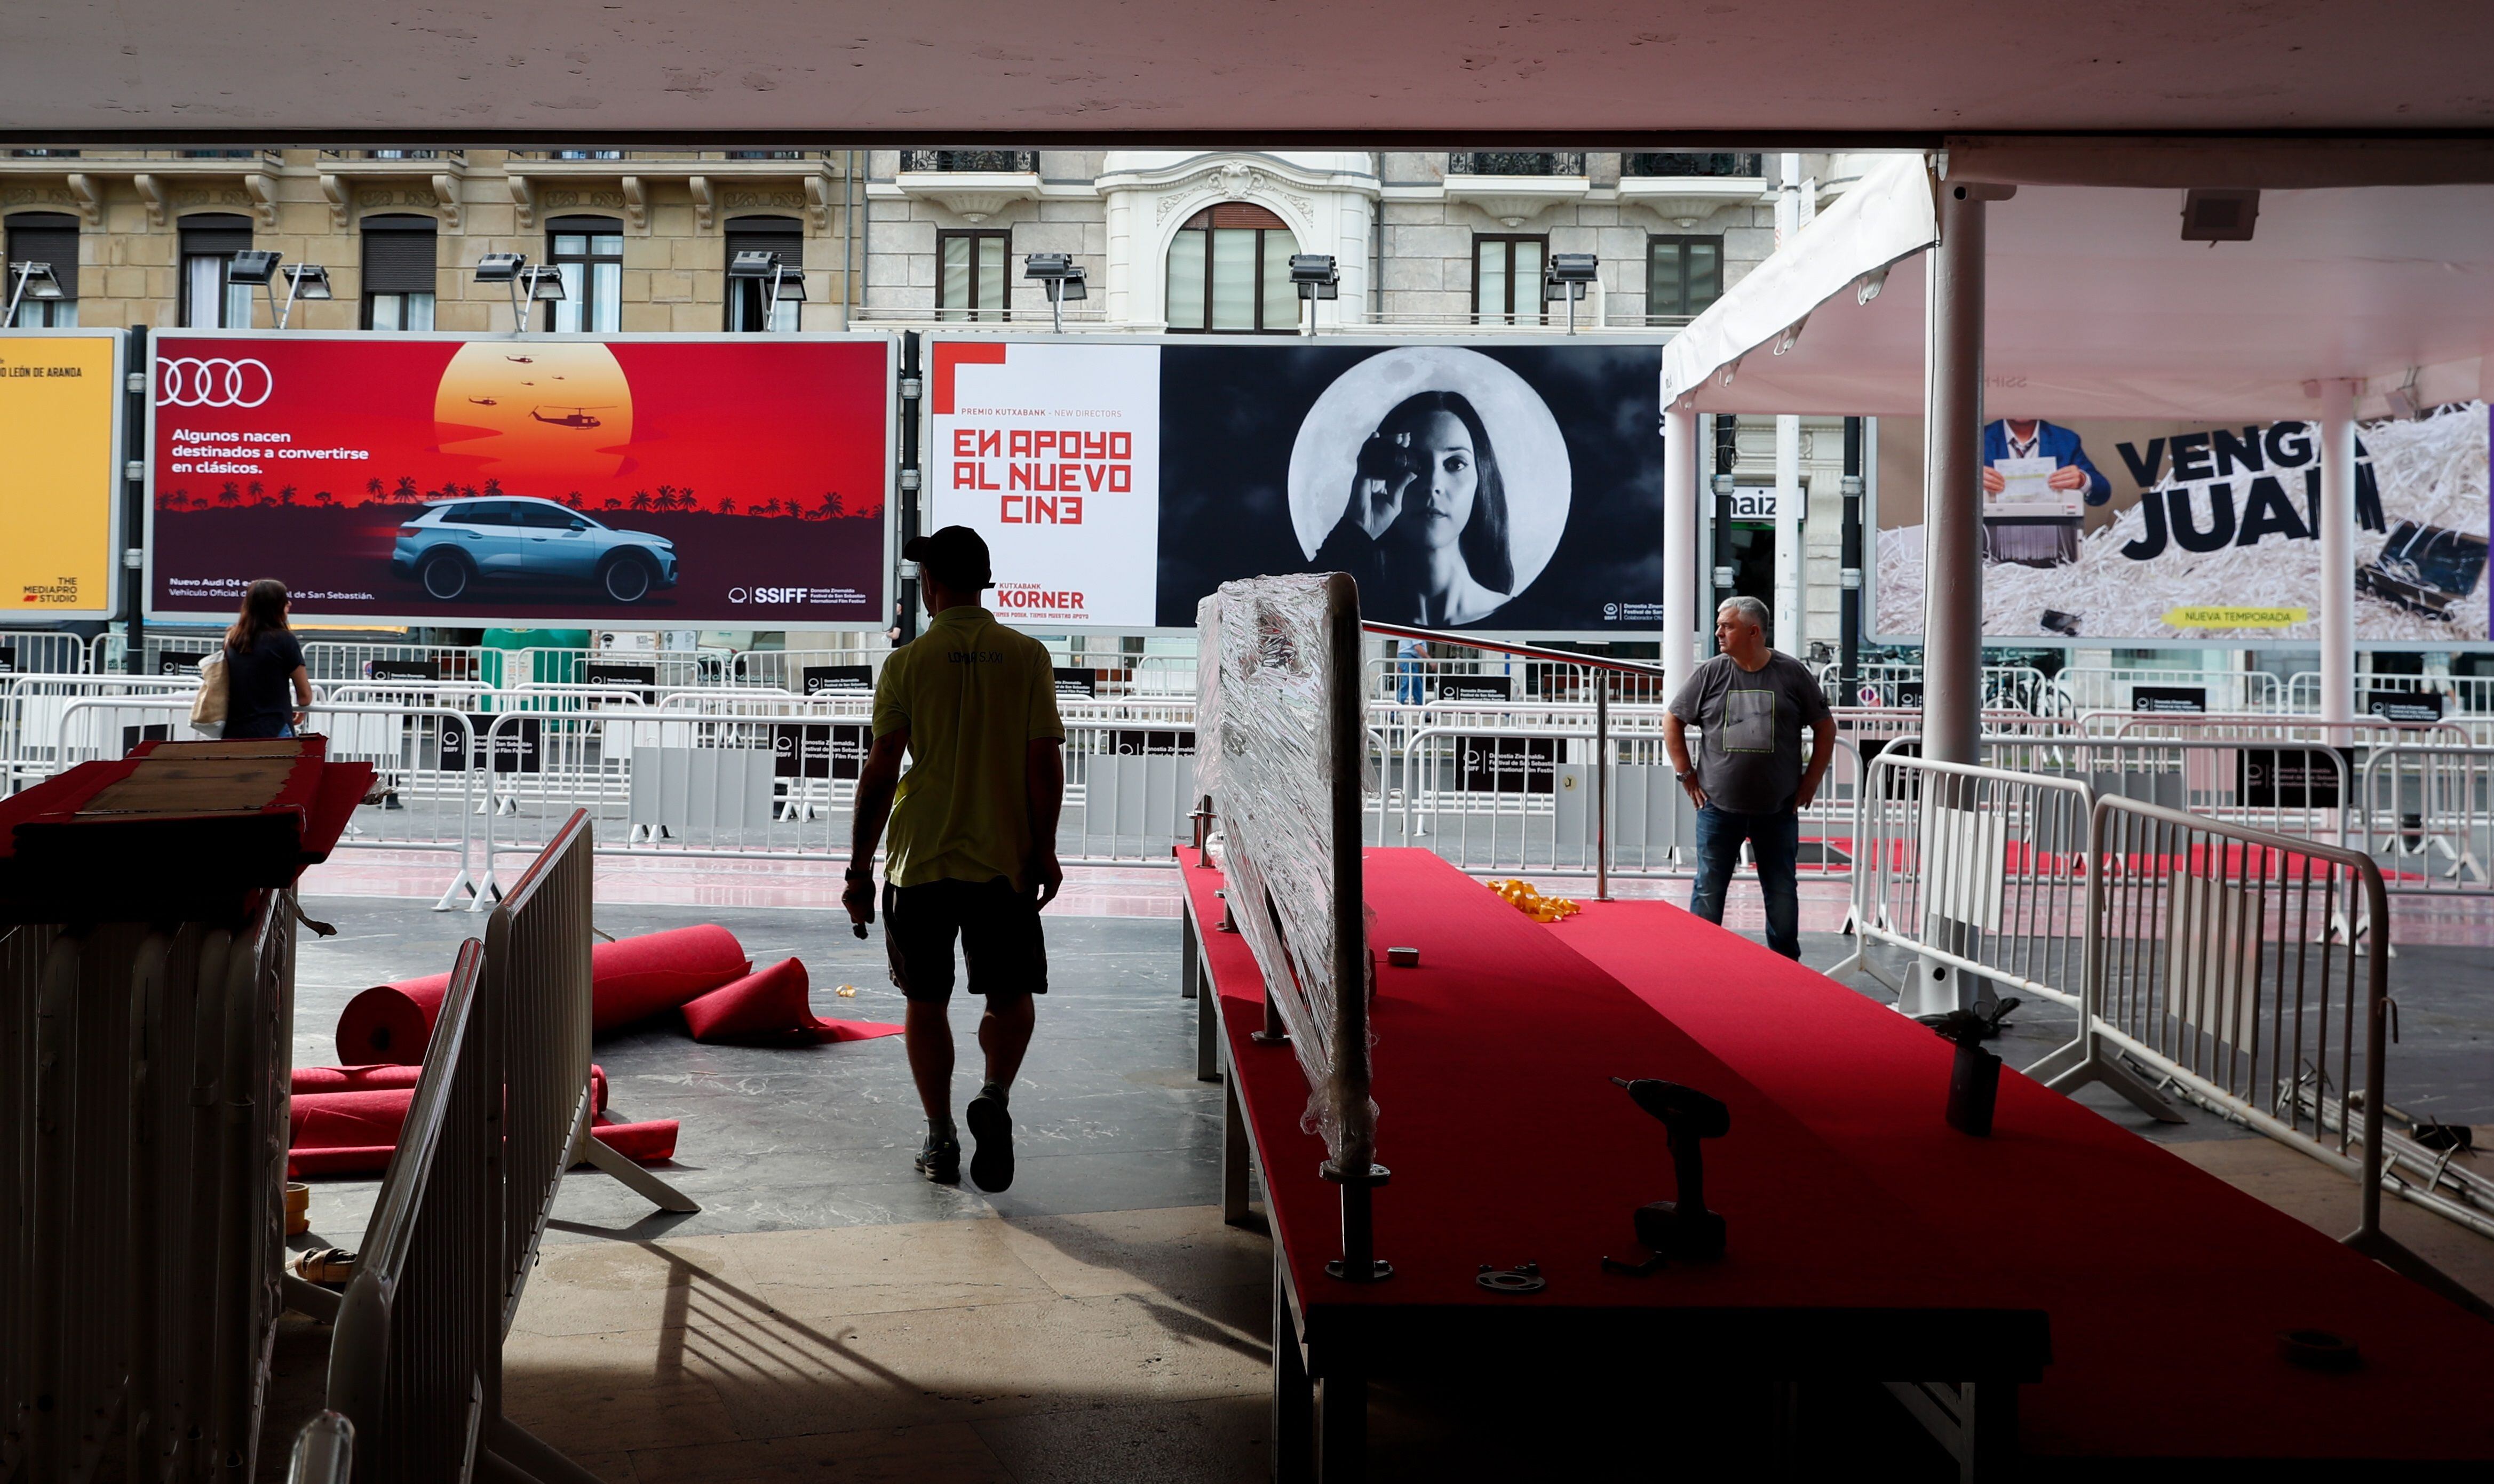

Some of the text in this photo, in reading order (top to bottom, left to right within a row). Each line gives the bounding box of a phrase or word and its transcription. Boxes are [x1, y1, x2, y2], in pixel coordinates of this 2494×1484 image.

[9, 365, 30, 377] LEÓN
[33, 367, 44, 377] DE
[995, 409, 1046, 417] KUTXABANK
[172, 429, 291, 444] Algunos nacen
[954, 429, 1132, 459] EN APOYO
[172, 445, 369, 460] destinados a convertirse
[172, 461, 263, 474] en clásicos.
[954, 461, 1131, 492] AL NUEVO
[58, 577, 77, 585] THE
[226, 579, 240, 587] Q4
[23, 586, 78, 594] MEDIAPRO
[209, 589, 239, 597] Oficial
[327, 592, 375, 600] Sebastián.
[754, 587, 808, 603] SSIFF
[998, 591, 1084, 609] KORNER
[2185, 611, 2291, 622] NUEVA TEMPORADA
